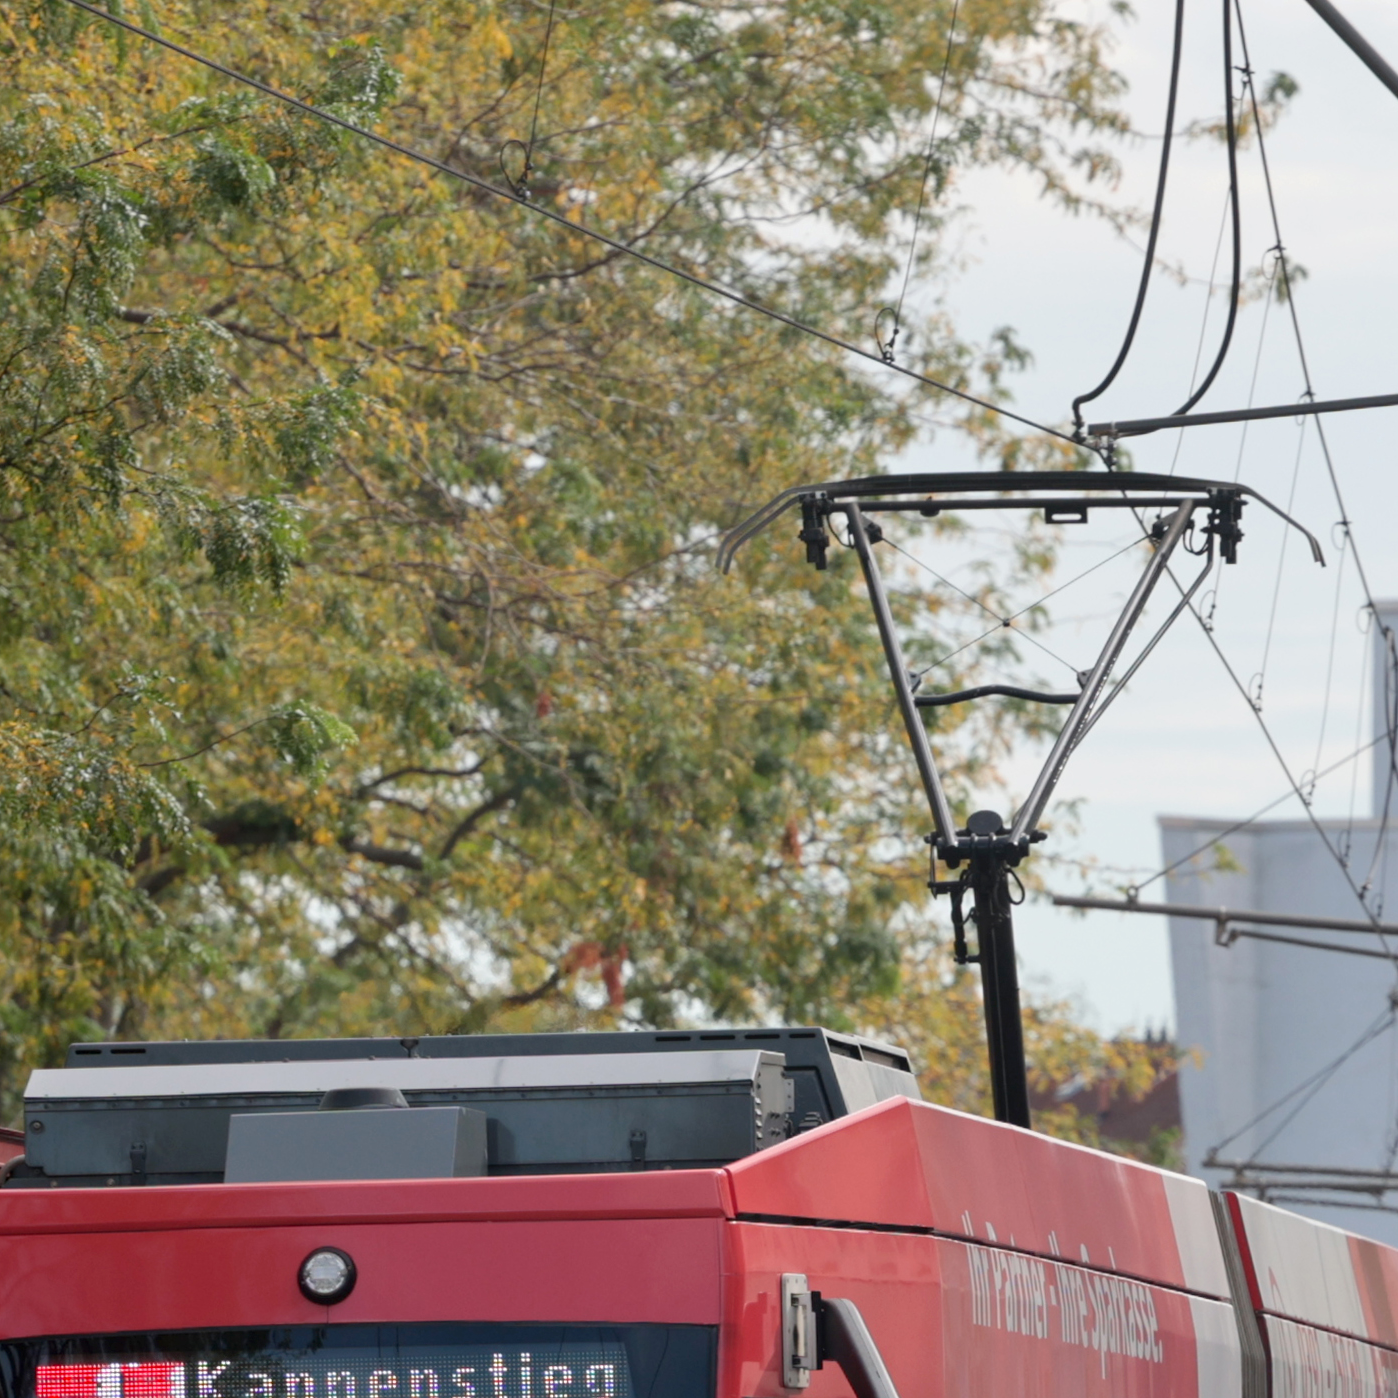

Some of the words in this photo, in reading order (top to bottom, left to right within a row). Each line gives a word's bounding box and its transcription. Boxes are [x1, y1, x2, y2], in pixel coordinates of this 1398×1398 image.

[961, 1209, 992, 1328] Ihr
[985, 1221, 1049, 1340] Partner
[1047, 1230, 1089, 1349] Ihre
[1080, 1242, 1164, 1381] Sparkasse.
